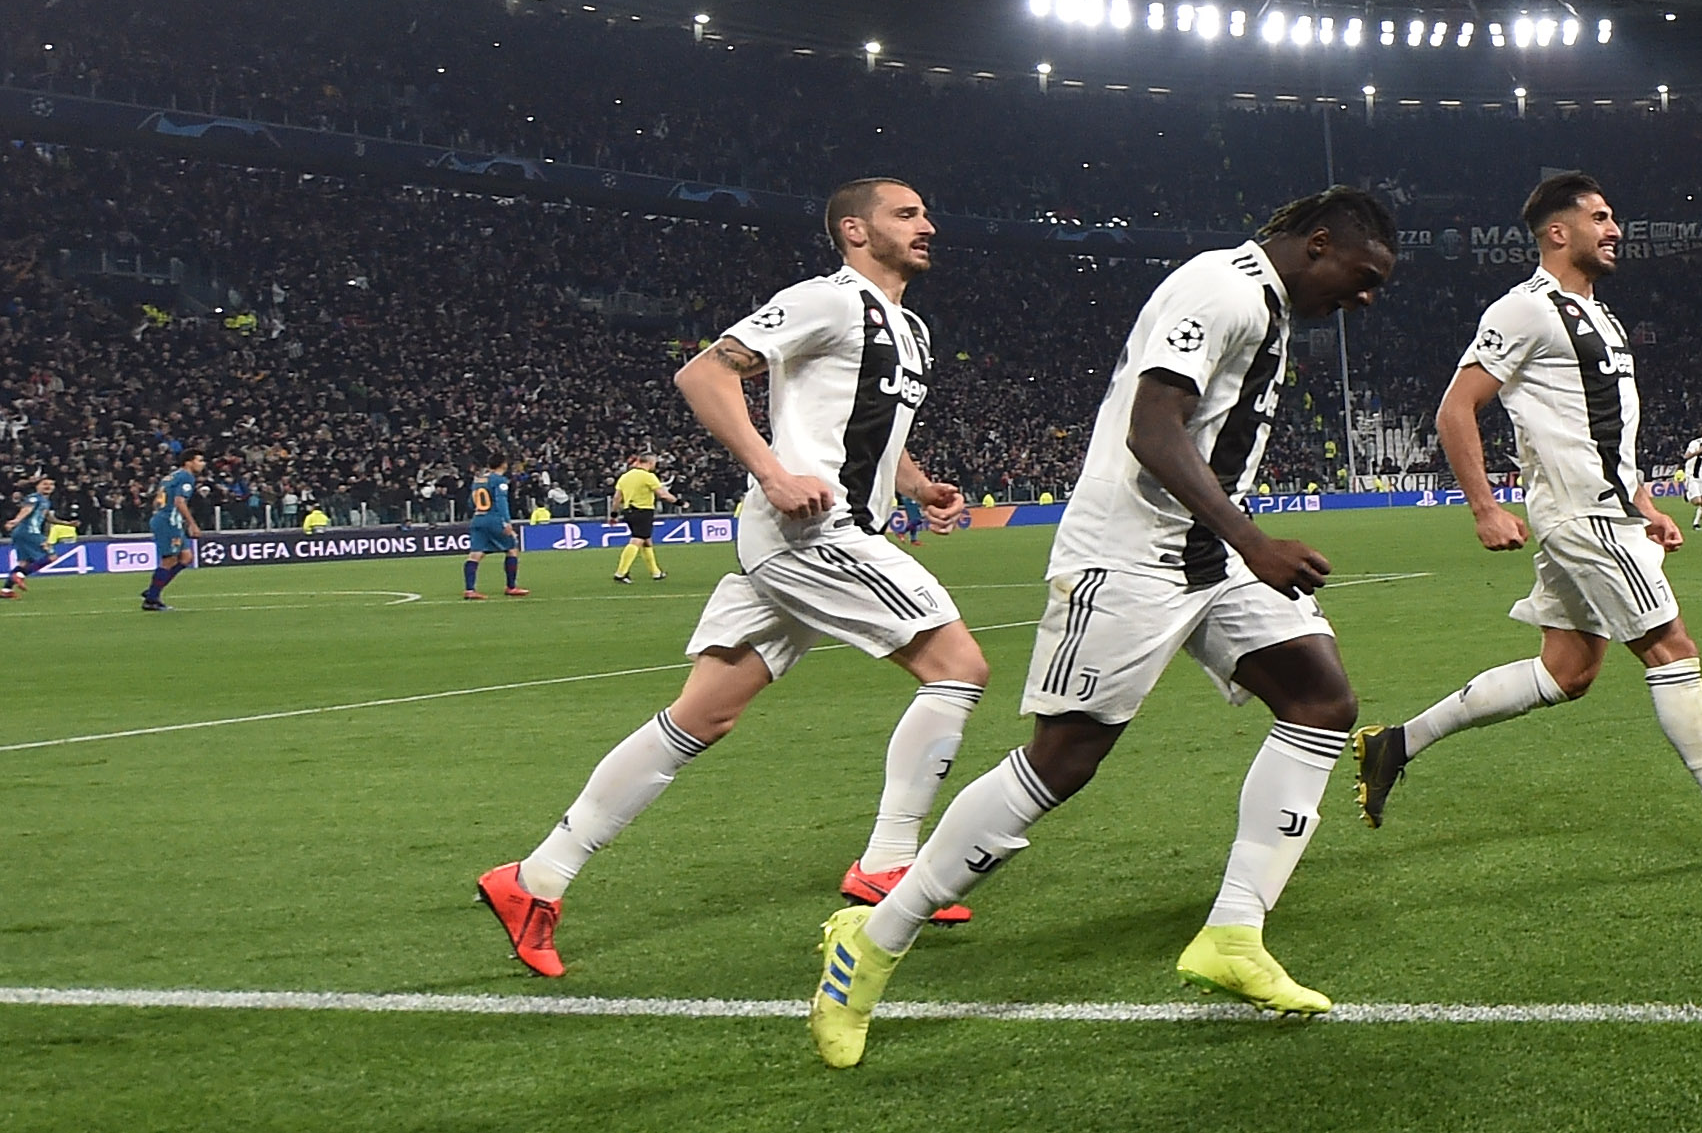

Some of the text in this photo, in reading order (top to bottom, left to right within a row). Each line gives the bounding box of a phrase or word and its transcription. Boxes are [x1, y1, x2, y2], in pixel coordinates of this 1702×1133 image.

[1470, 225, 1538, 246] MA
[1472, 247, 1541, 266] TOSC
[1258, 496, 1302, 513] PS4
[1445, 489, 1508, 505] P4
[601, 520, 728, 547] P4 Pro
[230, 534, 471, 560] UEFA CHAMPIONS LEAG
[115, 550, 150, 565] Pro
